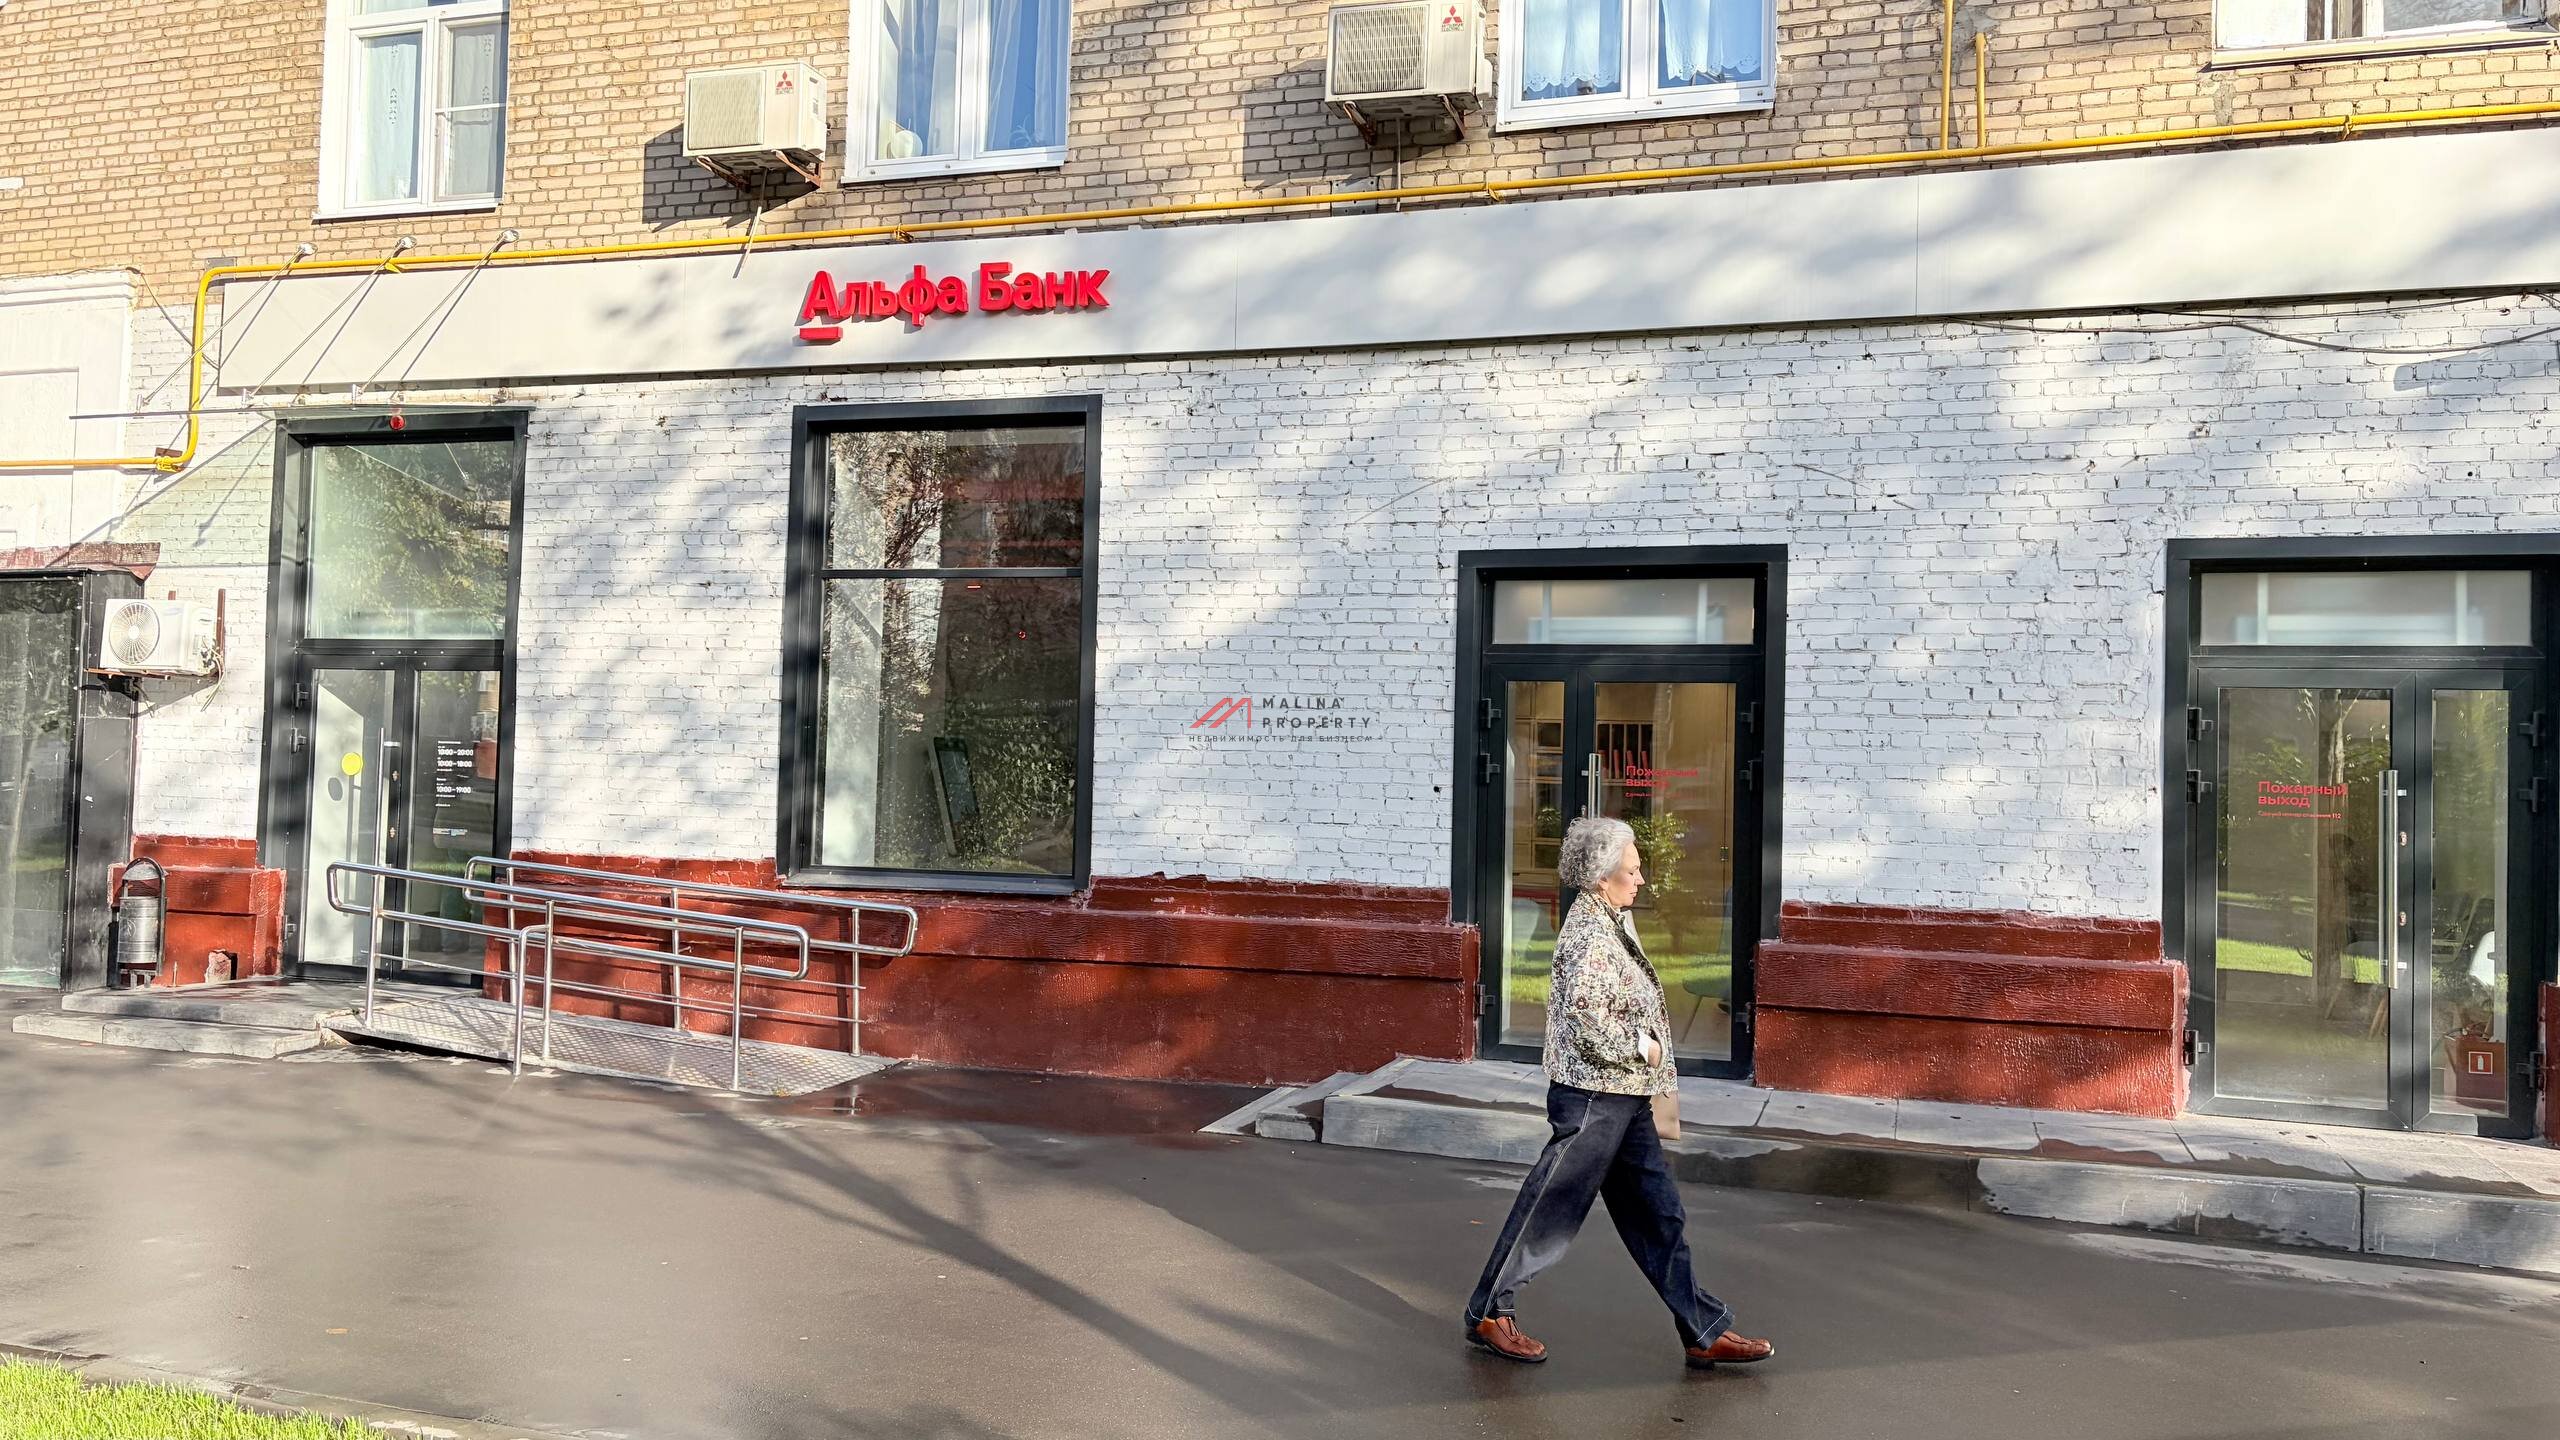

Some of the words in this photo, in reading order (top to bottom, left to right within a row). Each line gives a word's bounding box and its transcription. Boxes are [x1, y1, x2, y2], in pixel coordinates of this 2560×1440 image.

[802, 264, 969, 327] Альфа
[979, 261, 1111, 312] Банк
[2258, 781, 2348, 796] Пожарный
[2258, 796, 2311, 808] выход
